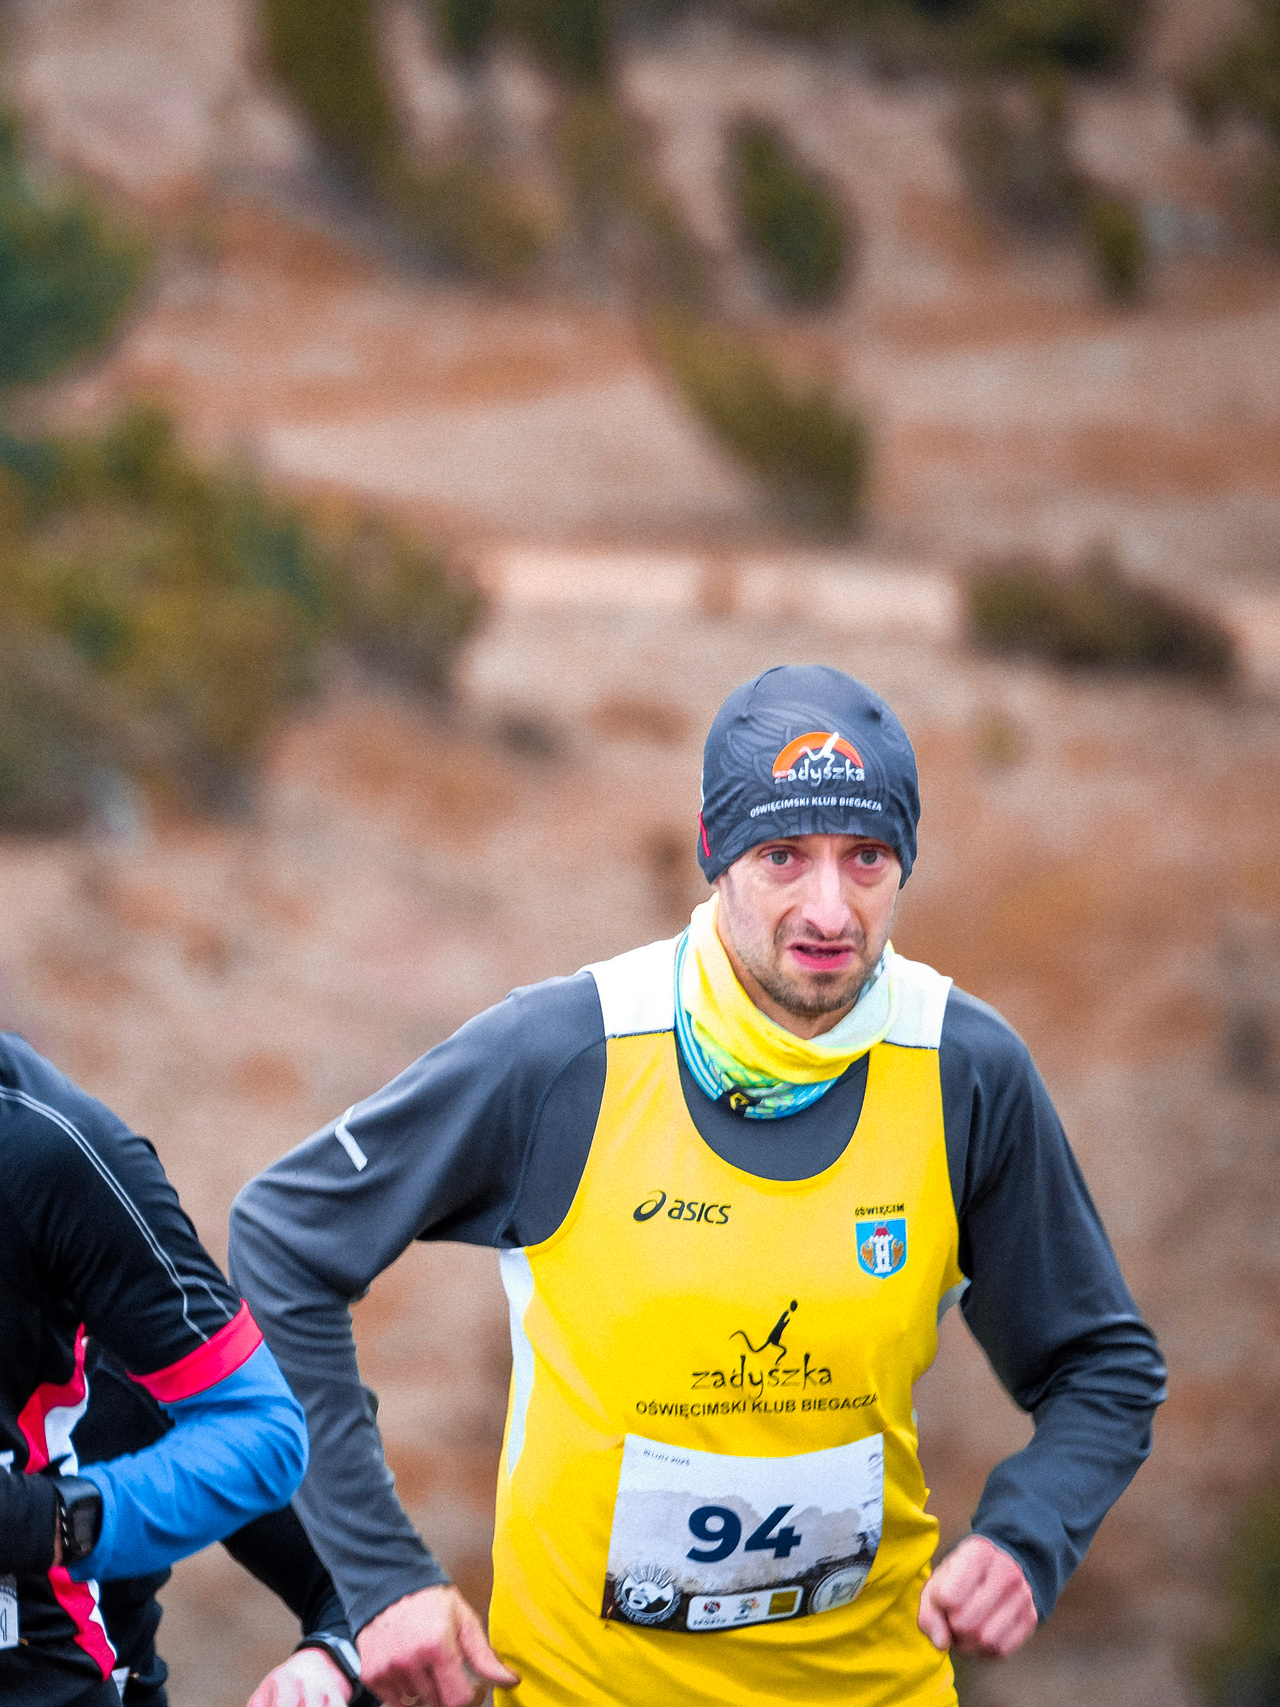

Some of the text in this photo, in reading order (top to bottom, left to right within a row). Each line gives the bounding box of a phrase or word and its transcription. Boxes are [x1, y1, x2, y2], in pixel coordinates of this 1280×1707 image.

[774, 758, 866, 787] zadyszka
[750, 796, 882, 818] OŚWIĘCIMSKI KLUB BIEGACZA
[667, 1198, 732, 1225] asics
[854, 1202, 905, 1217] OŚWIĘCIM
[691, 1351, 833, 1400] zadyszka
[635, 1392, 878, 1419] OŚWIĘCIMSKI KLUB BIEGACZA
[686, 1504, 802, 1563] 94
